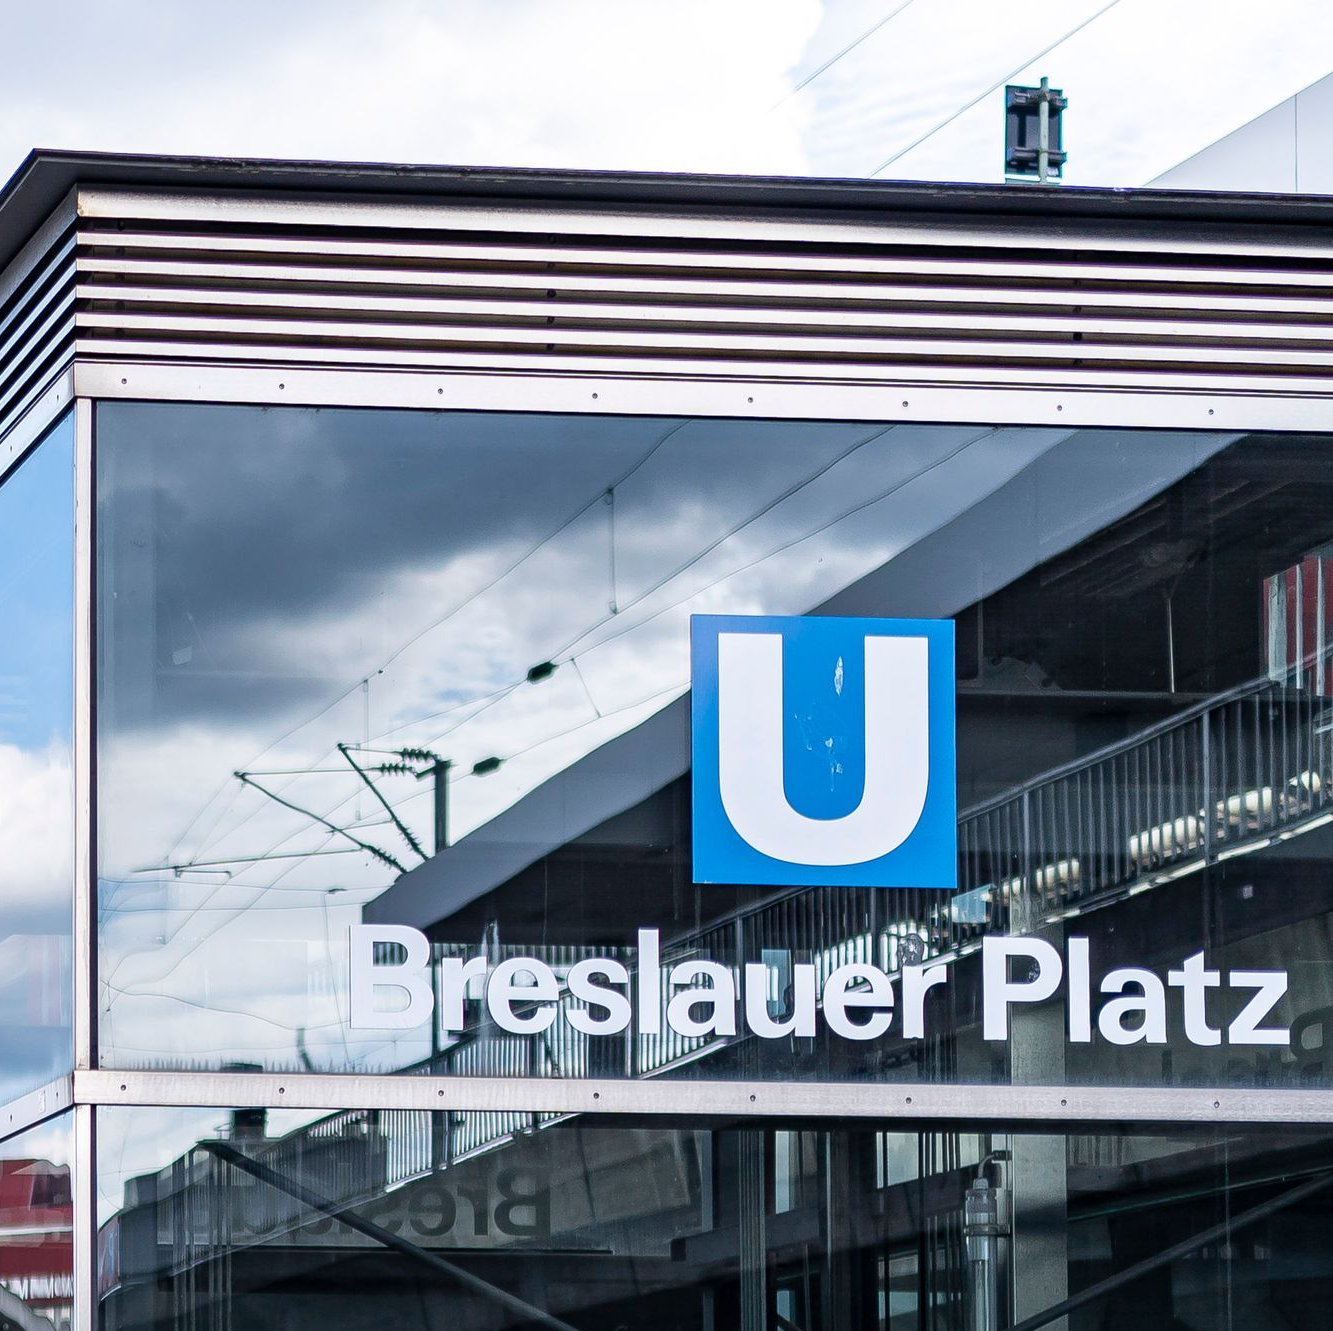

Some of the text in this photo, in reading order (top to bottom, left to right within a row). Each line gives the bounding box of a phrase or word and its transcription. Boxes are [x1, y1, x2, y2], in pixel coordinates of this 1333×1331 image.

[718, 633, 929, 866] U
[349, 925, 948, 1041] Breslauer
[982, 935, 1289, 1046] Platz
